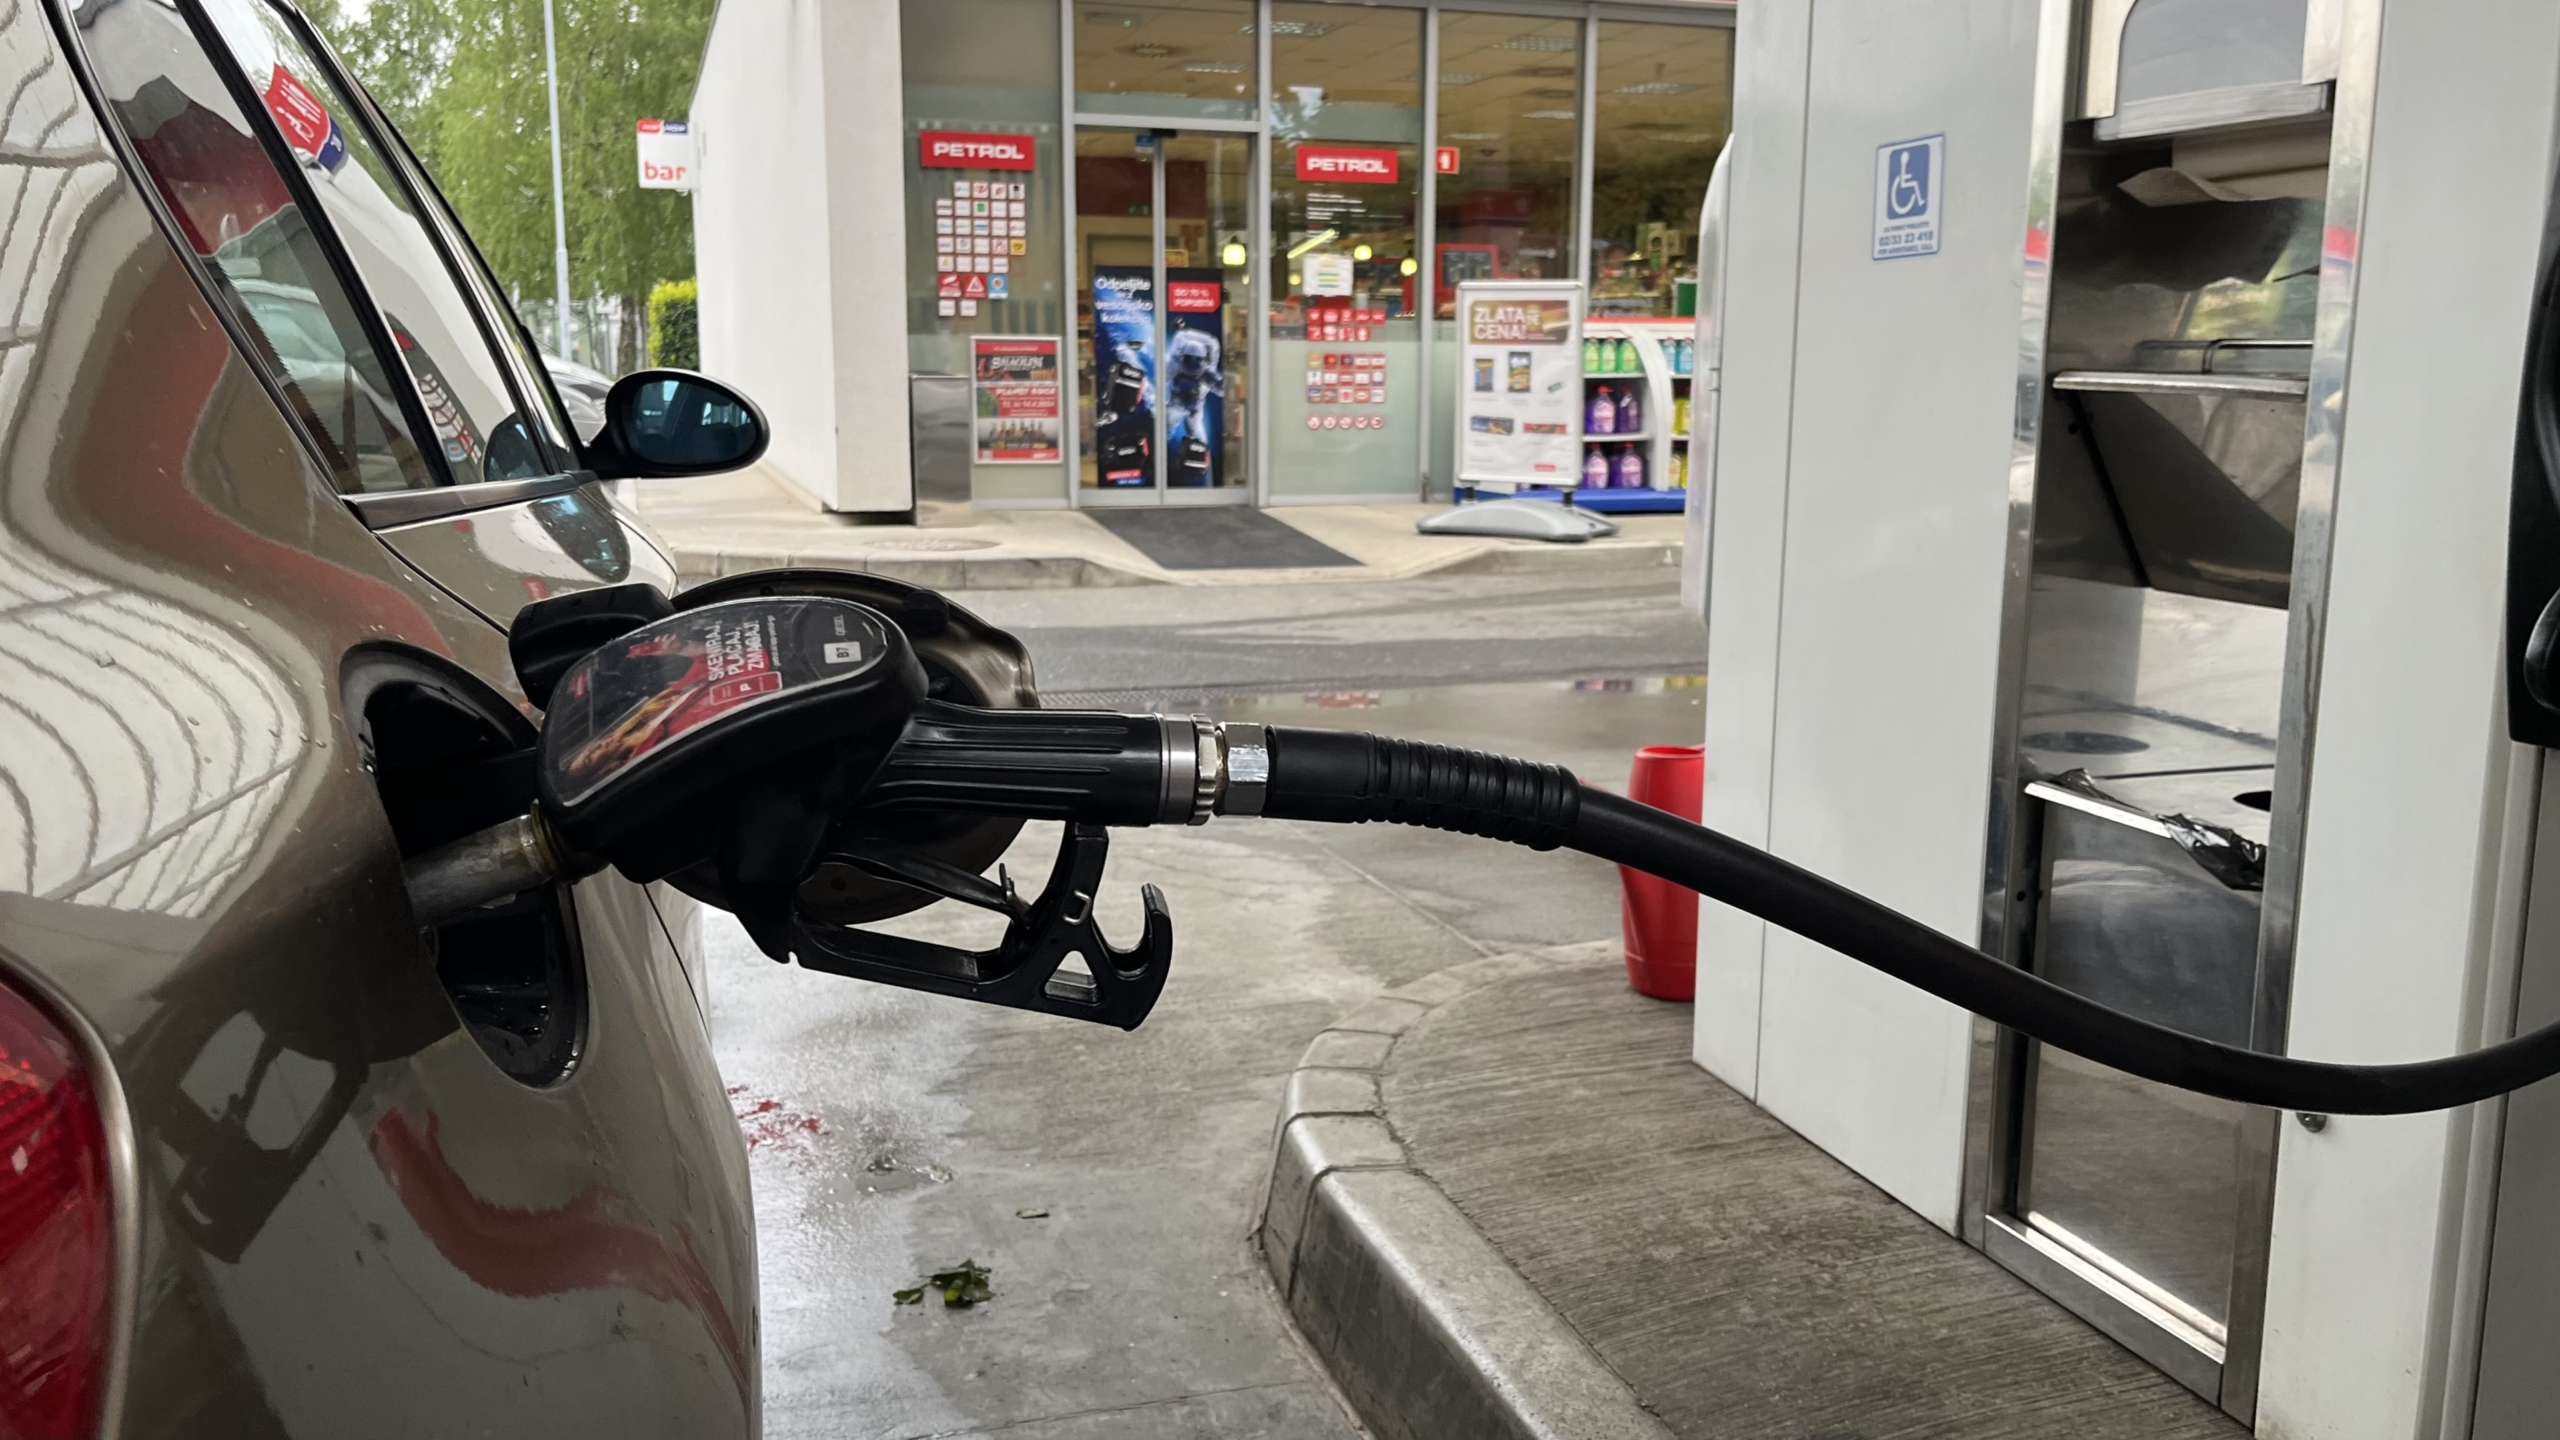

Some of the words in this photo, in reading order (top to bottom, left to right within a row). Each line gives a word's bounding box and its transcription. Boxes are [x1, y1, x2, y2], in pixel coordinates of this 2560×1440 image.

[933, 142, 1025, 160] PETROL
[645, 161, 686, 181] bar
[1306, 157, 1390, 174] PETROL
[1904, 233, 1915, 244] 23
[1474, 307, 1526, 323] ZLATA
[1474, 324, 1527, 340] CENA!
[704, 621, 725, 681] SKENIRAJ,
[743, 620, 765, 671] ZMAGAJ!
[836, 647, 849, 658] B7
